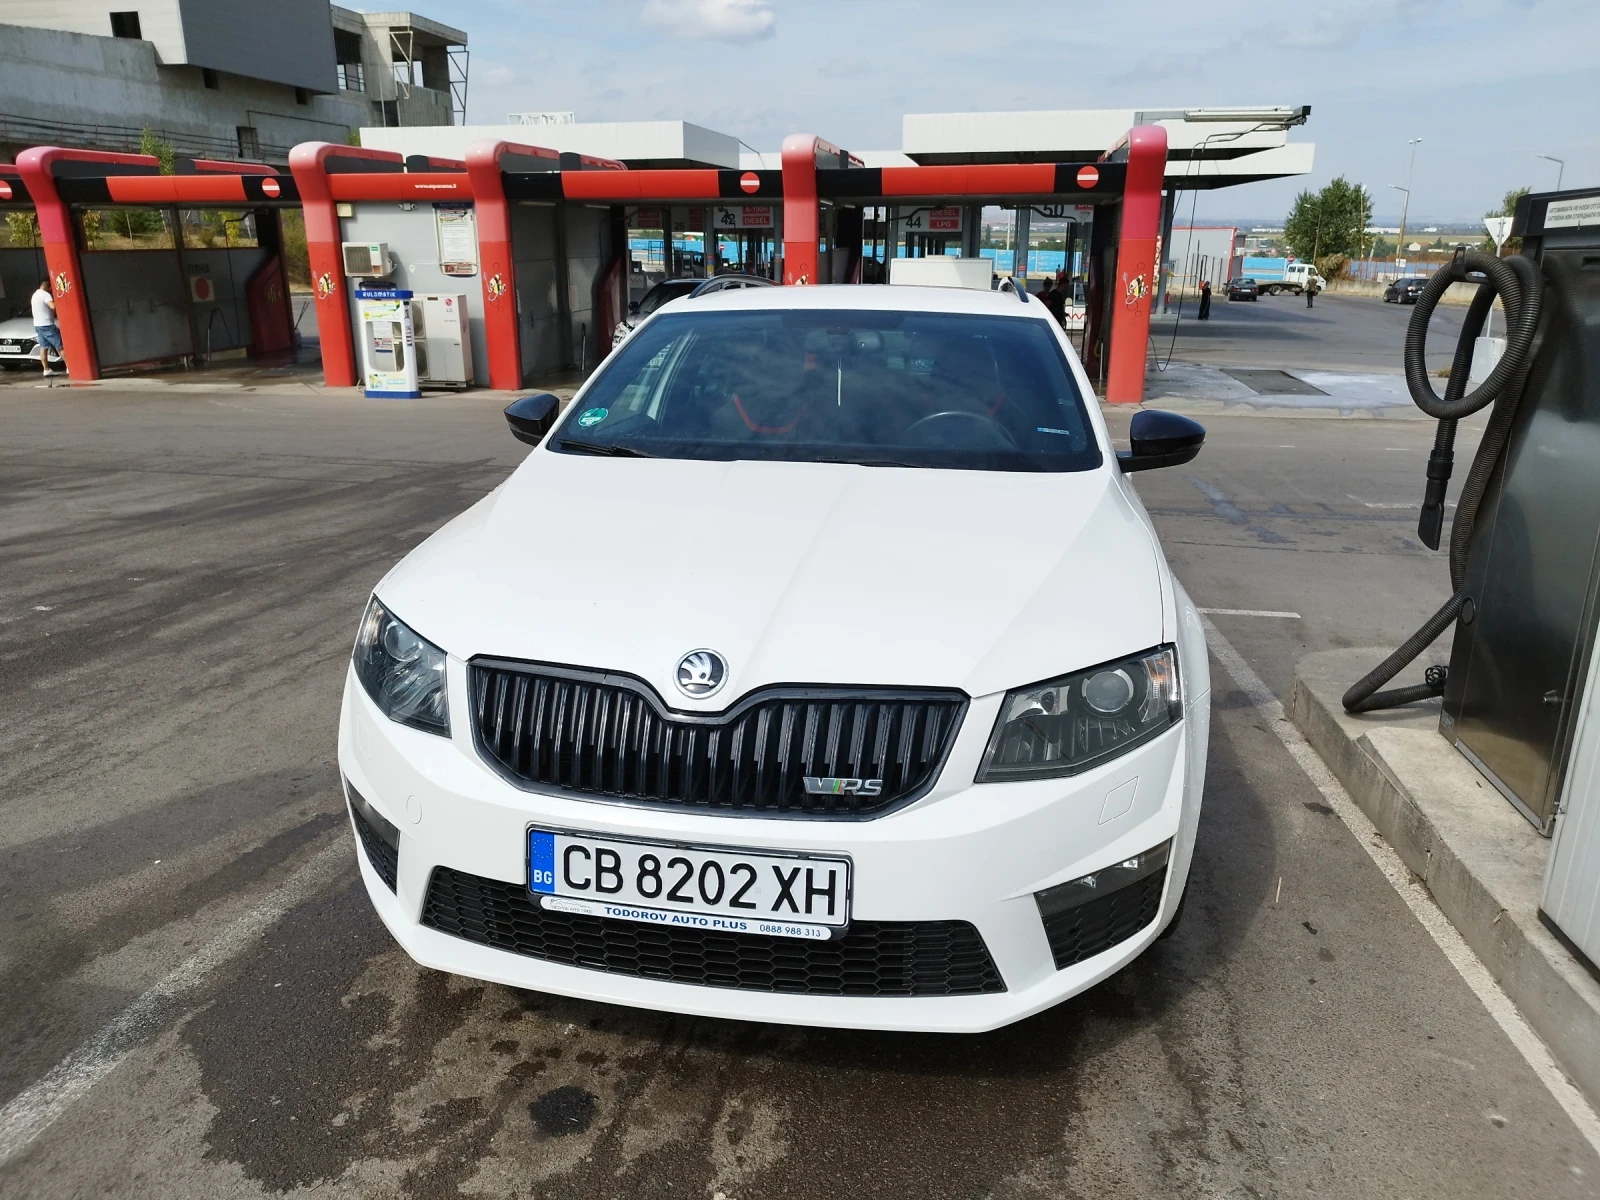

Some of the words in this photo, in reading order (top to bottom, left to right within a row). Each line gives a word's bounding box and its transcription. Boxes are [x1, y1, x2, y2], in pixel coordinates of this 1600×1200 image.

[674, 222, 685, 230] 26
[906, 216, 922, 228] 44
[533, 869, 553, 884] BG
[563, 844, 624, 894] CB
[636, 853, 758, 910] 8202
[770, 865, 837, 916] XH
[604, 906, 668, 921] TODOROV
[671, 915, 708, 926] AUTO
[712, 920, 748, 930] PLUS
[759, 924, 783, 934] 0888
[785, 926, 802, 936] 988
[805, 928, 821, 937] 313
